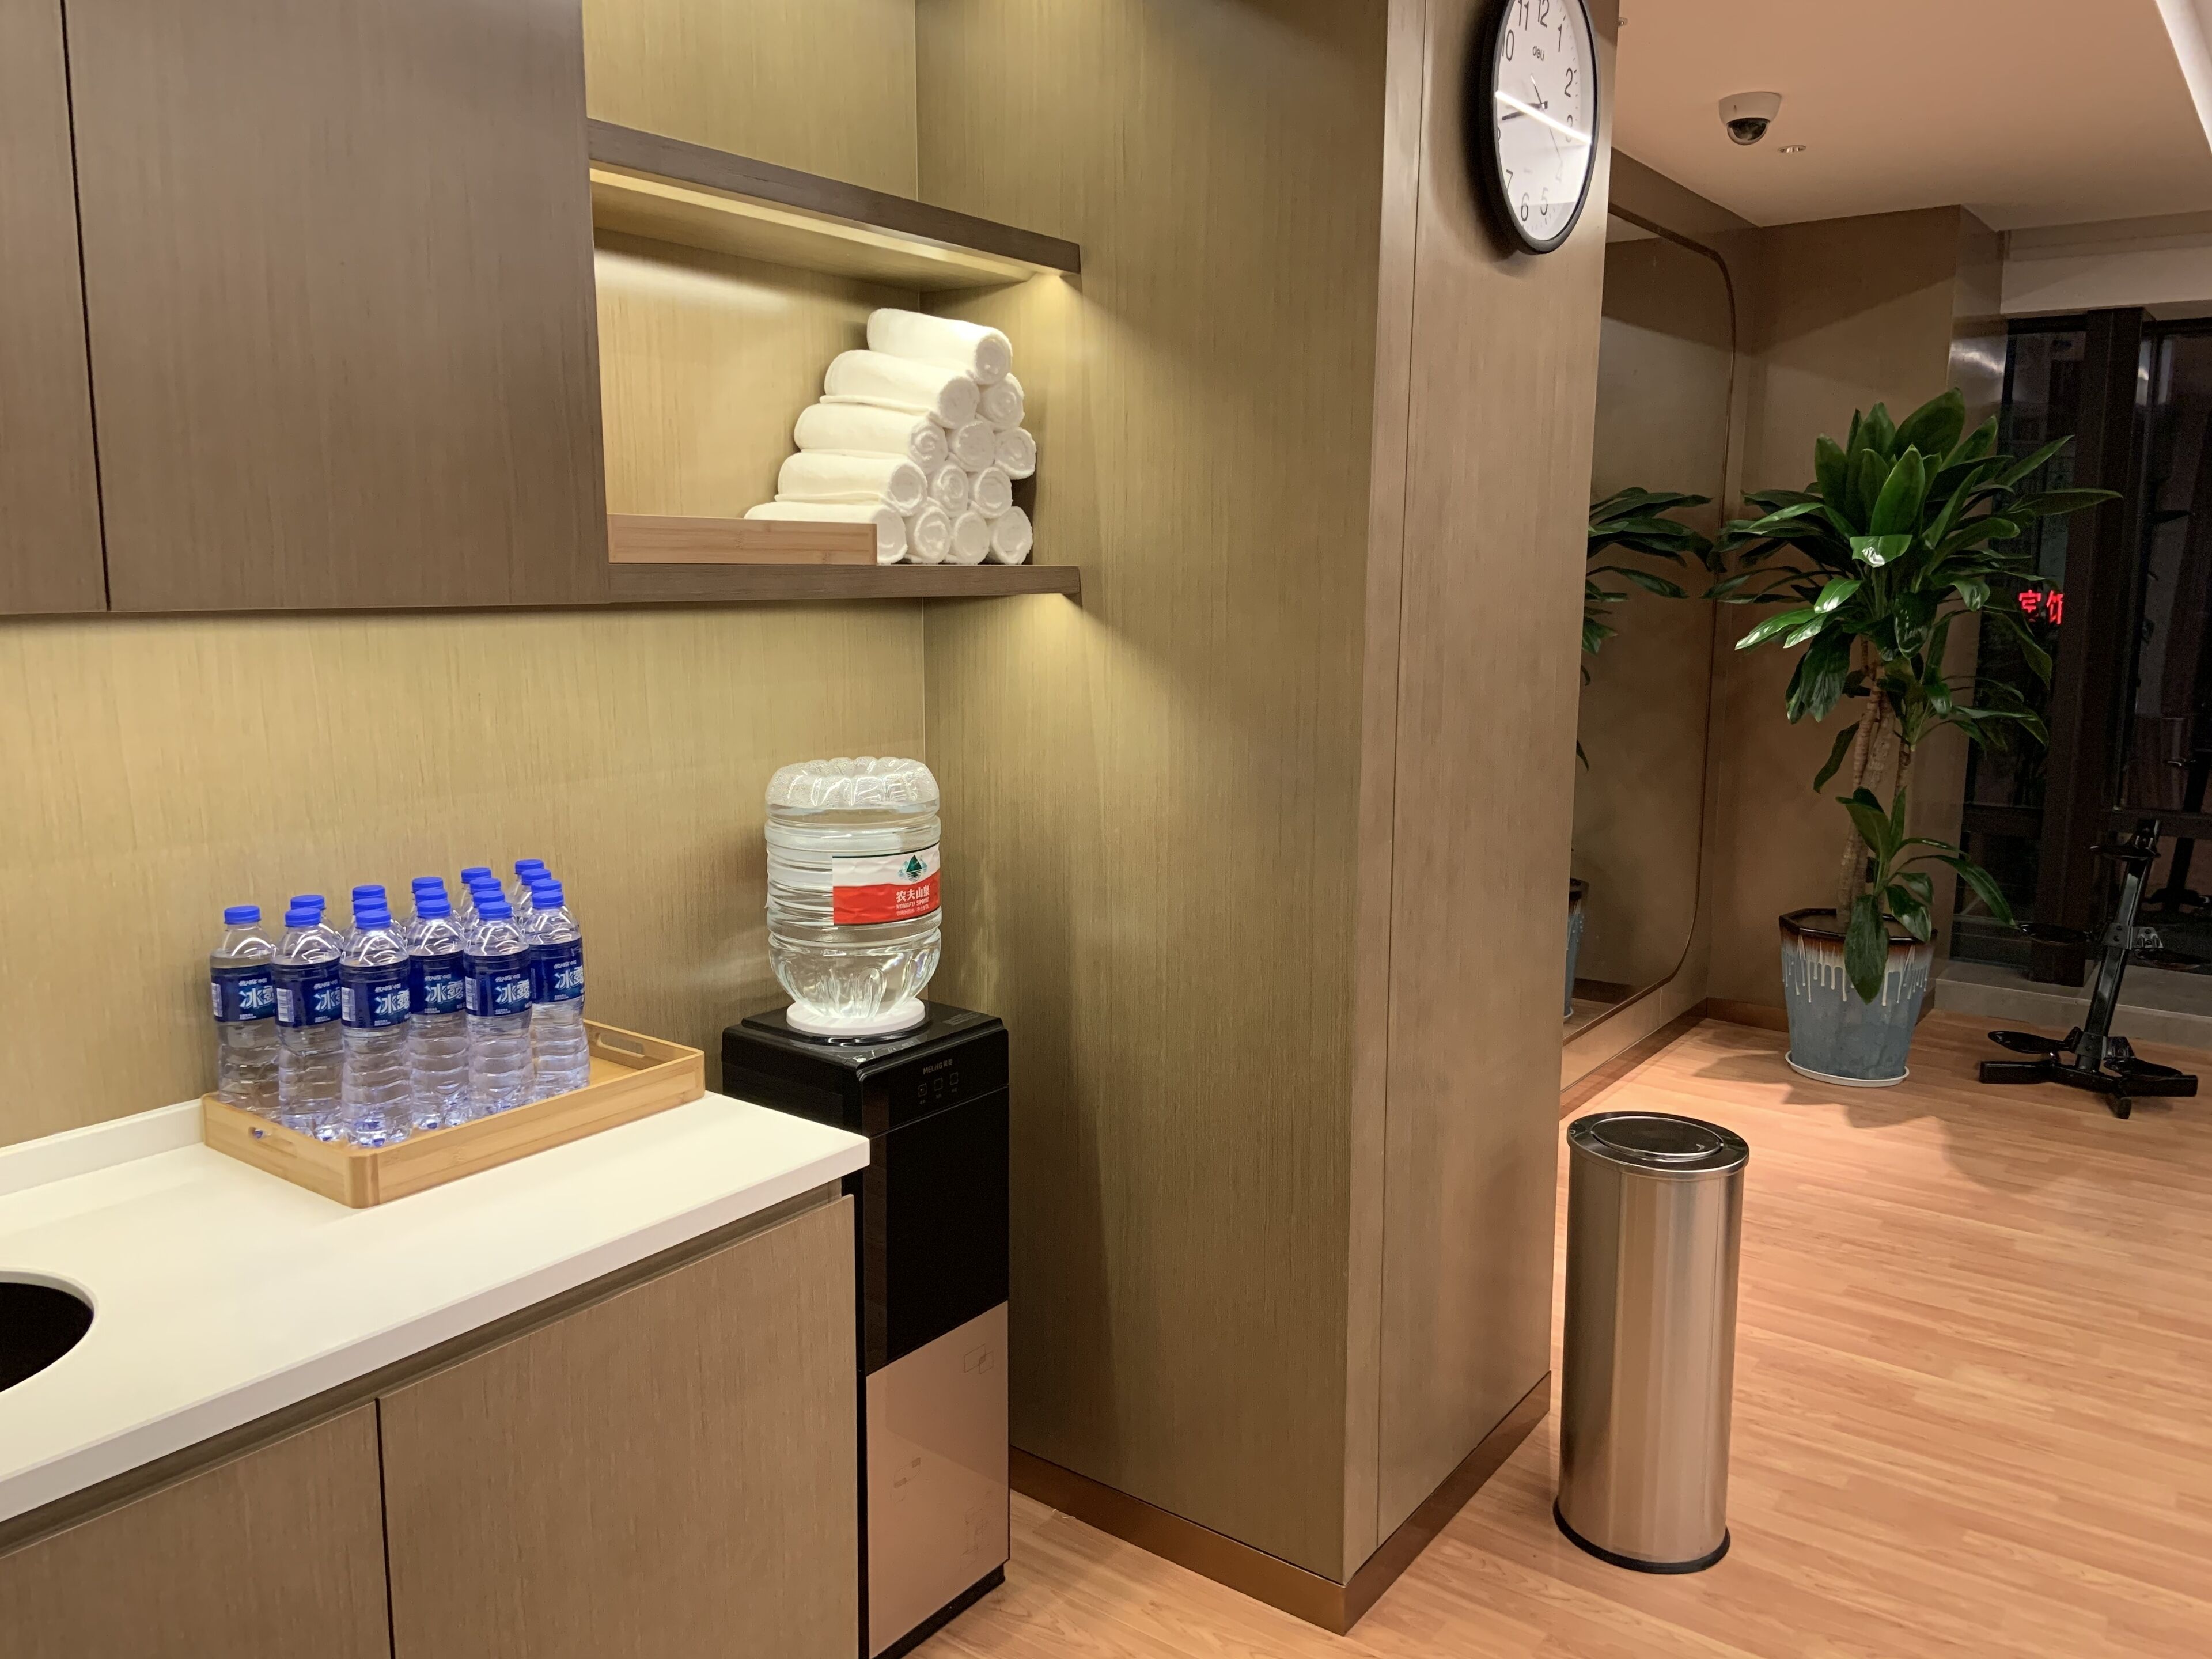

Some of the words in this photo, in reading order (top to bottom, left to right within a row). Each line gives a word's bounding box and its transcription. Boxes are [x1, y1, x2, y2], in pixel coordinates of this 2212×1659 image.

[1518, 0, 1529, 31] 11
[1537, 0, 1550, 28] 12
[1557, 24, 1563, 52] 1
[1564, 67, 1573, 97] 2
[1521, 192, 1529, 222] 6
[1540, 187, 1548, 215] 5
[896, 885, 930, 903] 农夫山泉
[896, 901, 916, 910] NONGFU
[374, 988, 410, 1014] 冰露
[425, 980, 464, 1004] 冰露
[495, 979, 531, 1003] 冰露
